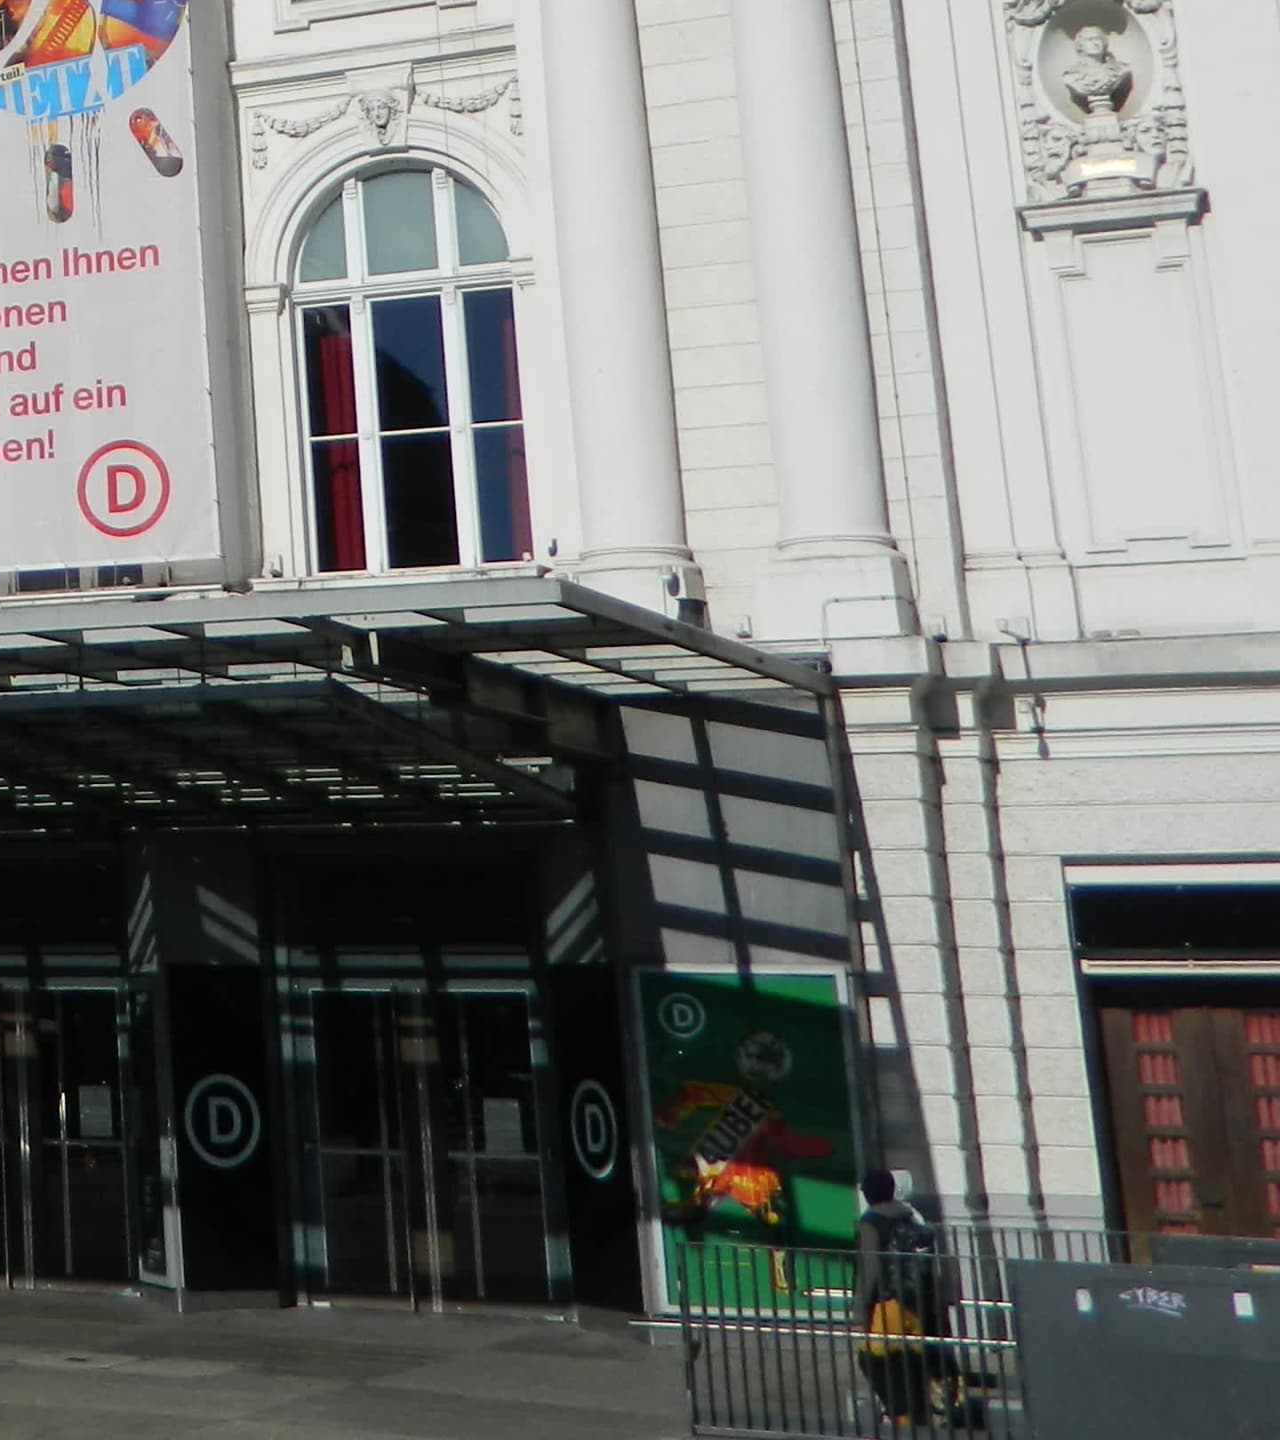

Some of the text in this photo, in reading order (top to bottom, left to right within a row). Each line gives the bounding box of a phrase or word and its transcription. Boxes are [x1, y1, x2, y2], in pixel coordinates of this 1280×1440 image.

[61, 244, 160, 278] Ihnen
[9, 383, 64, 417] auf
[72, 378, 127, 411] ein
